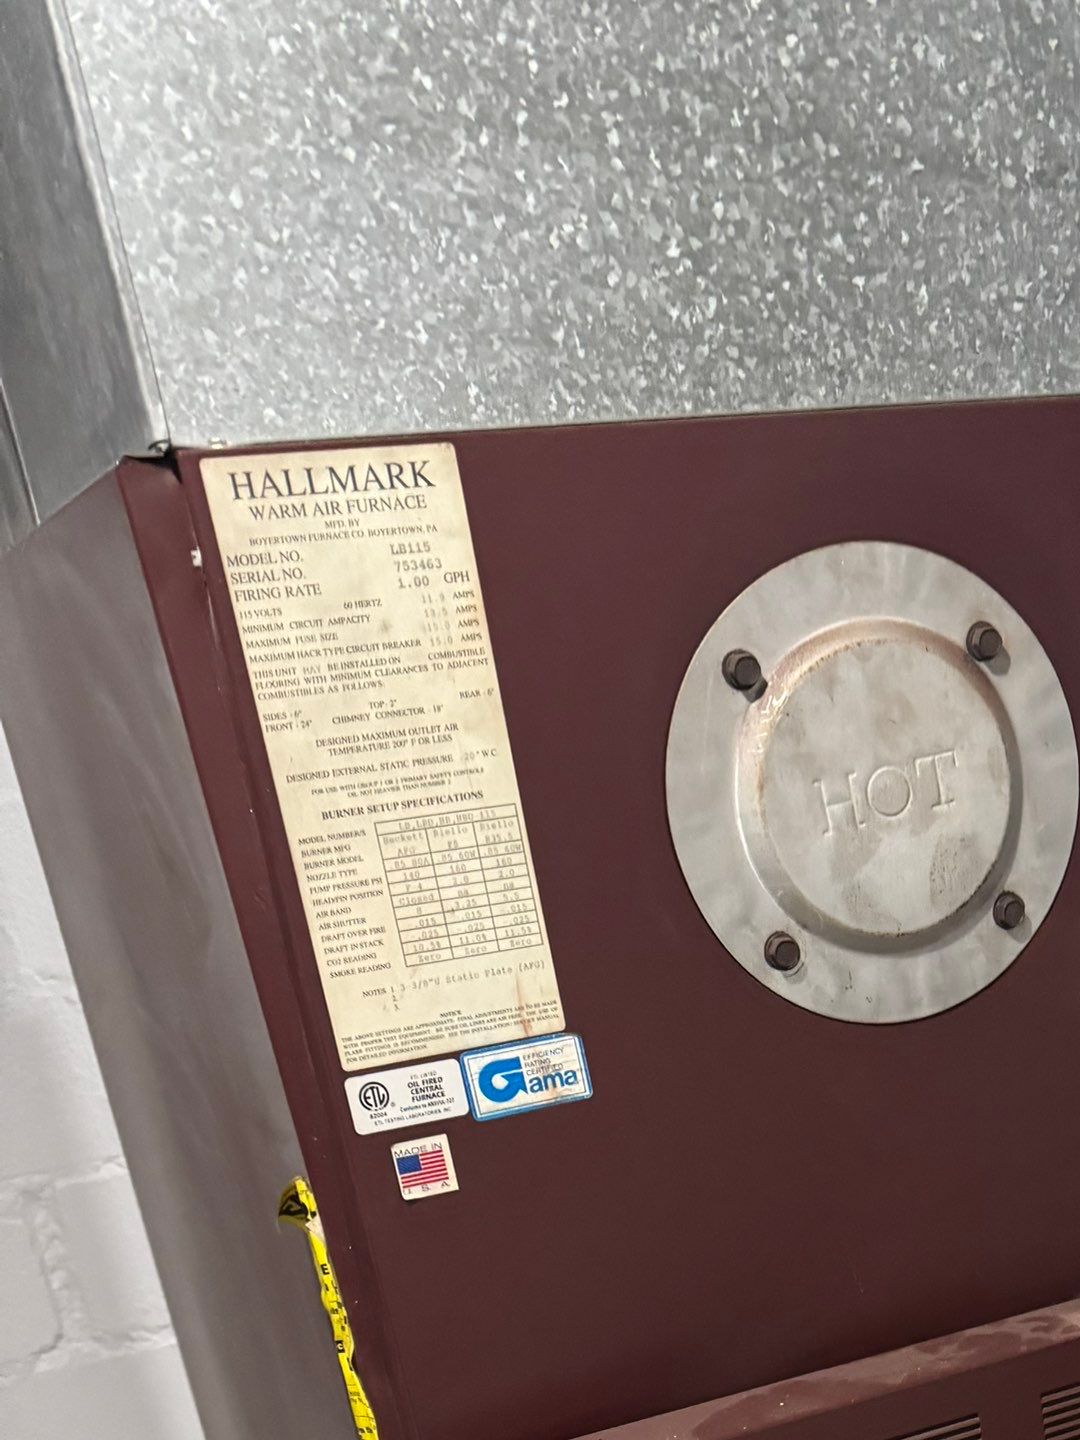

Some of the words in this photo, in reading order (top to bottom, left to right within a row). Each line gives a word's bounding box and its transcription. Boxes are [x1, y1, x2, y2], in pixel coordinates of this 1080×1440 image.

[229, 461, 435, 500] HALLMARK
[249, 503, 307, 520] WARM
[313, 500, 342, 516] AIR
[346, 494, 427, 513] FURNACE
[347, 518, 359, 527] BY
[249, 534, 306, 546] BOYERTOWN
[308, 531, 350, 542] FURNACE
[226, 552, 277, 567] MODEL
[279, 550, 303, 563] NO.
[389, 541, 431, 555] LB115
[230, 569, 280, 584] SERIAL
[281, 567, 303, 581] NO.
[393, 557, 442, 572] 753463
[234, 587, 281, 602] FIRING
[284, 583, 322, 598] RATE
[398, 575, 429, 589] 1.00
[443, 570, 470, 583] GPH
[239, 610, 253, 620] 115
[253, 607, 282, 617] VOLTS
[354, 598, 382, 608] HERTZ
[452, 590, 475, 599] AMPS
[241, 622, 284, 634] MINIMUM
[289, 618, 323, 629] CIRCUIT
[327, 614, 370, 626] AMPACITY
[455, 604, 478, 613] AMPS
[245, 637, 291, 649] MAXIMUM
[295, 634, 317, 644] FUSE
[319, 632, 338, 641] SIZE
[249, 651, 295, 663] MAXIMUM
[322, 646, 345, 656] TYPE
[345, 643, 379, 654] CIRCUIT
[381, 639, 421, 650] BREAKER
[253, 669, 274, 679] THIS
[274, 666, 296, 677] UNIT
[327, 662, 338, 671] BE
[340, 658, 387, 670] INSTALLED
[388, 656, 401, 664] ON
[427, 647, 485, 660] COMBUSTIBLE
[255, 678, 300, 690] FLOORING
[303, 675, 327, 684] WITH
[330, 670, 371, 682] MINIMUM
[374, 664, 428, 677] CLEARANCES
[432, 662, 444, 671] TO
[447, 657, 488, 669] ADJACENT
[315, 734, 360, 747] DESIGNED
[361, 728, 406, 741] MAXIMUM
[408, 724, 441, 735] OUTLET
[444, 723, 459, 732] AIR
[321, 806, 364, 820] BURNER
[366, 801, 399, 813] SETUP
[401, 791, 483, 808] SPECIFICATIONS
[812, 750, 960, 839] HOT
[522, 1046, 564, 1060] EFFICIENCY
[524, 1057, 551, 1067] RATING
[526, 1062, 563, 1076] CERTIFIED
[407, 1081, 420, 1089] OIL
[421, 1076, 443, 1085] FIRED
[410, 1084, 442, 1095] CENTRAL
[361, 1084, 387, 1109] ETL
[411, 1091, 445, 1102] FURNACE
[394, 1145, 428, 1158] MADE
[431, 1142, 443, 1151] IN
